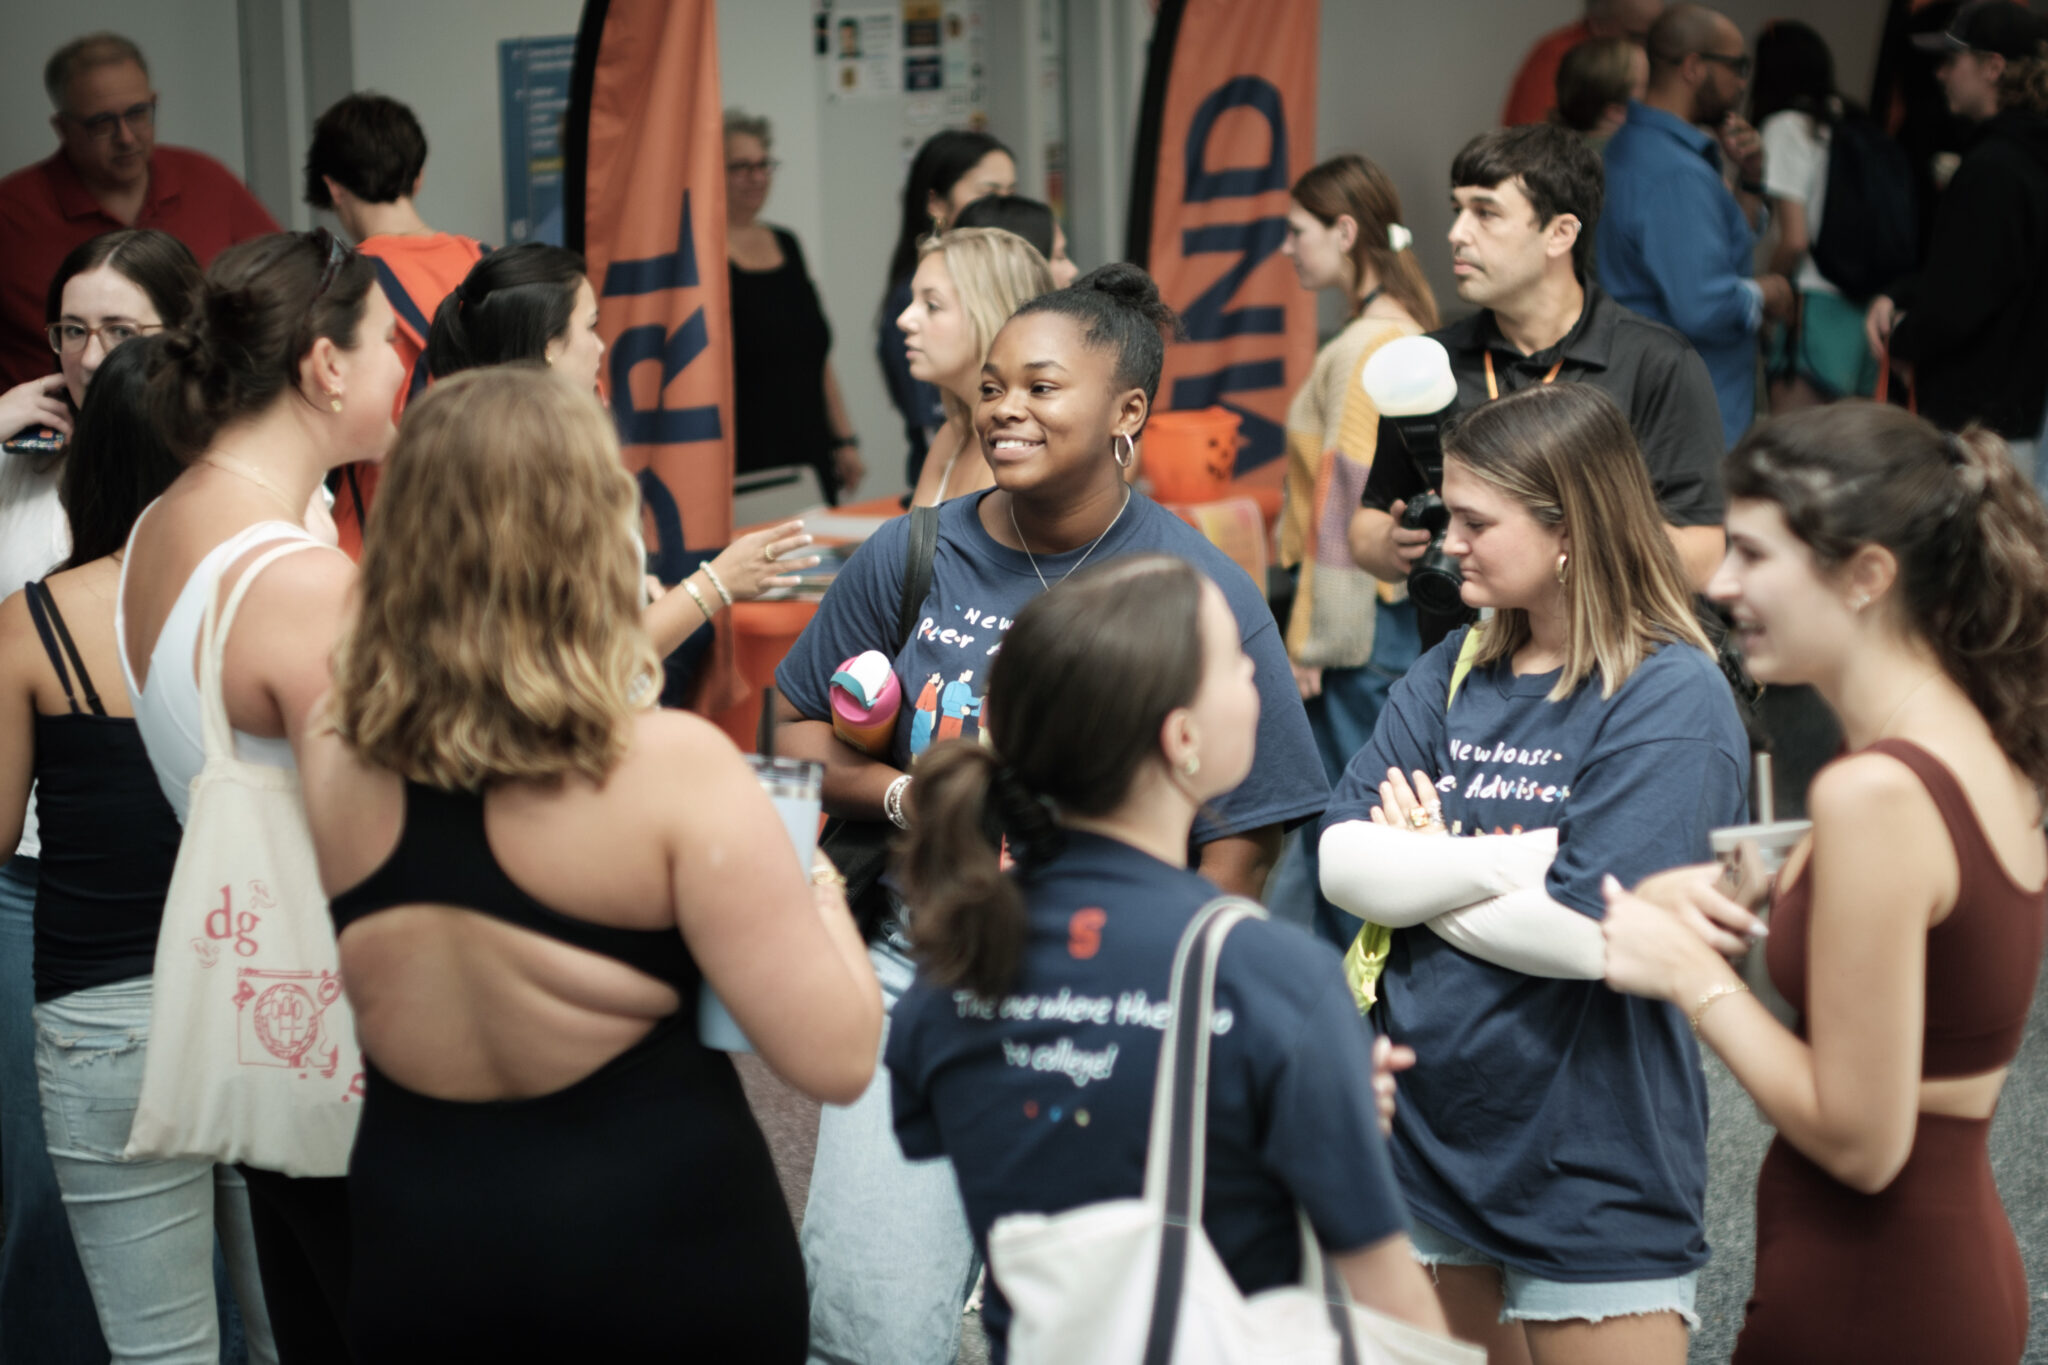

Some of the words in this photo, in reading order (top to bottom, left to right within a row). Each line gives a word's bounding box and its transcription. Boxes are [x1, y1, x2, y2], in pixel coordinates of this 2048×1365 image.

[1449, 739, 1553, 766] Newhouse
[204, 884, 262, 957] dg
[1067, 907, 1107, 960] S
[953, 989, 996, 1020] The
[999, 994, 1039, 1020] one
[1038, 986, 1112, 1024] where
[1116, 990, 1172, 1030] the
[1002, 1038, 1031, 1067] to
[1031, 1037, 1119, 1088] college!
